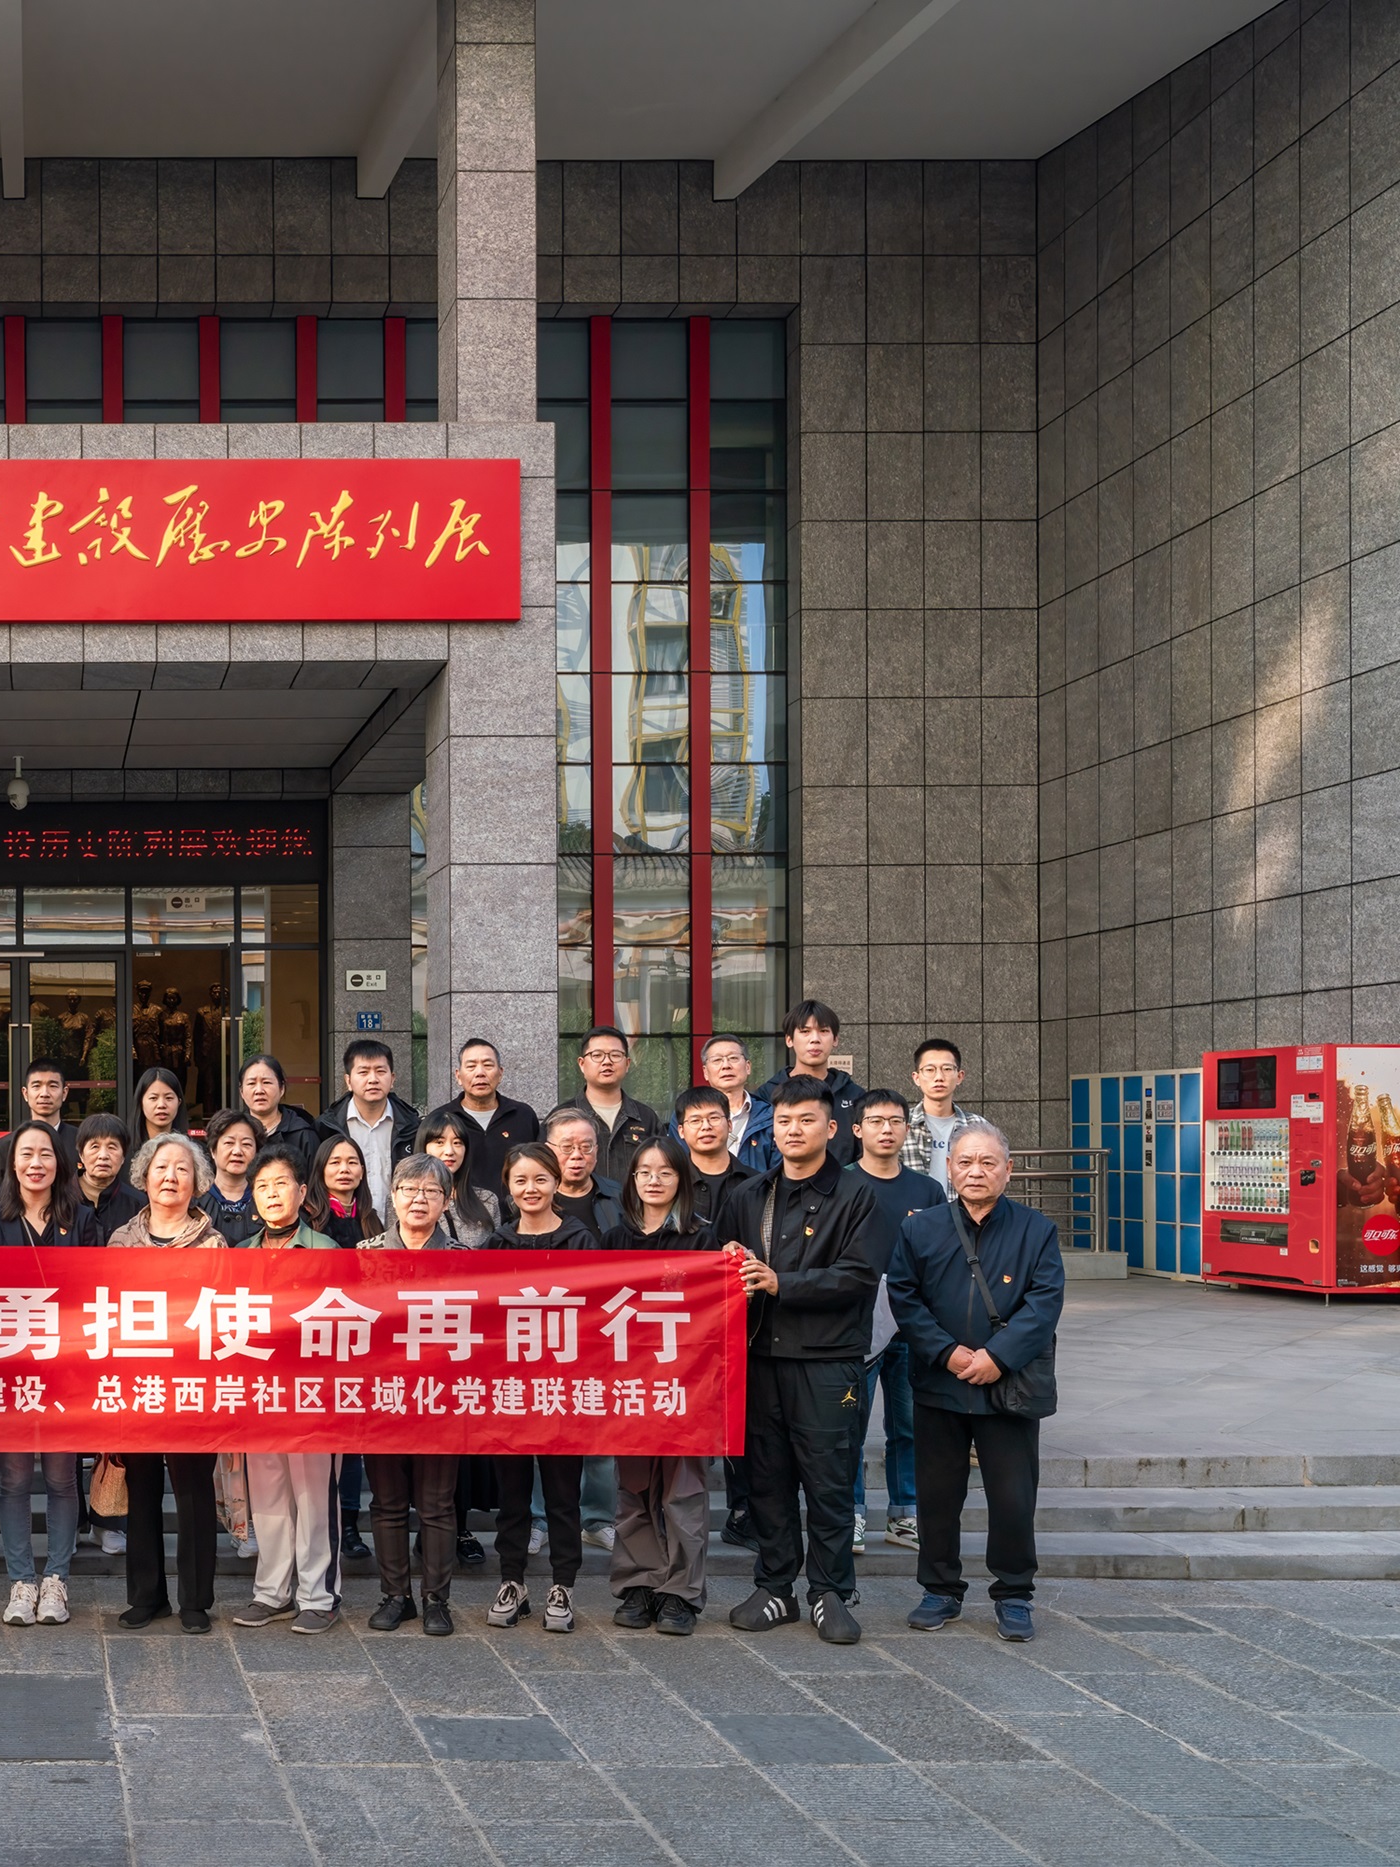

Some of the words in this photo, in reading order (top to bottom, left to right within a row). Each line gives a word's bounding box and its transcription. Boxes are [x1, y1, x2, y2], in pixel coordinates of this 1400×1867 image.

[1364, 1229, 1399, 1241] 可口可乐
[1360, 1264, 1384, 1273] 这感觉
